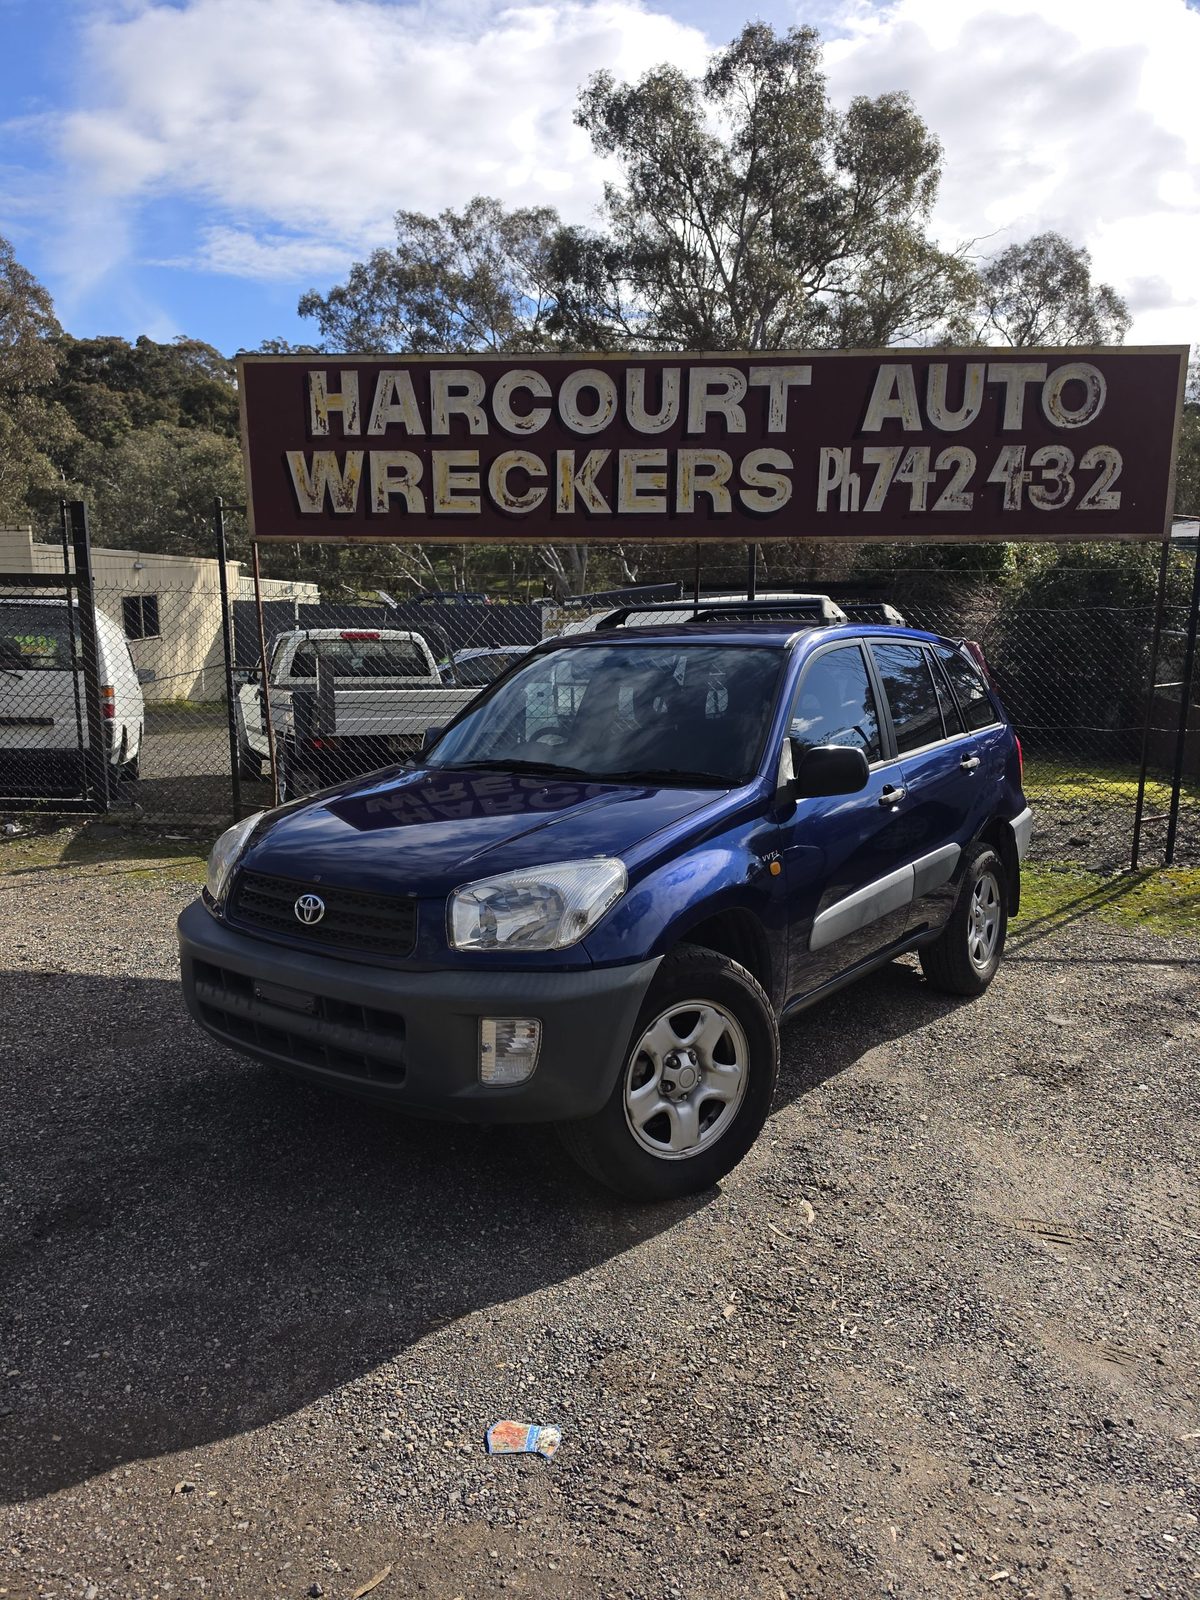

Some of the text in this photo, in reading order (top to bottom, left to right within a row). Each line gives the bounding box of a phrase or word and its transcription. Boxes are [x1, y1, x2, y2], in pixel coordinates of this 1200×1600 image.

[308, 362, 1107, 436] HARCOURT AUTO
[285, 447, 794, 514] WRECKERS
